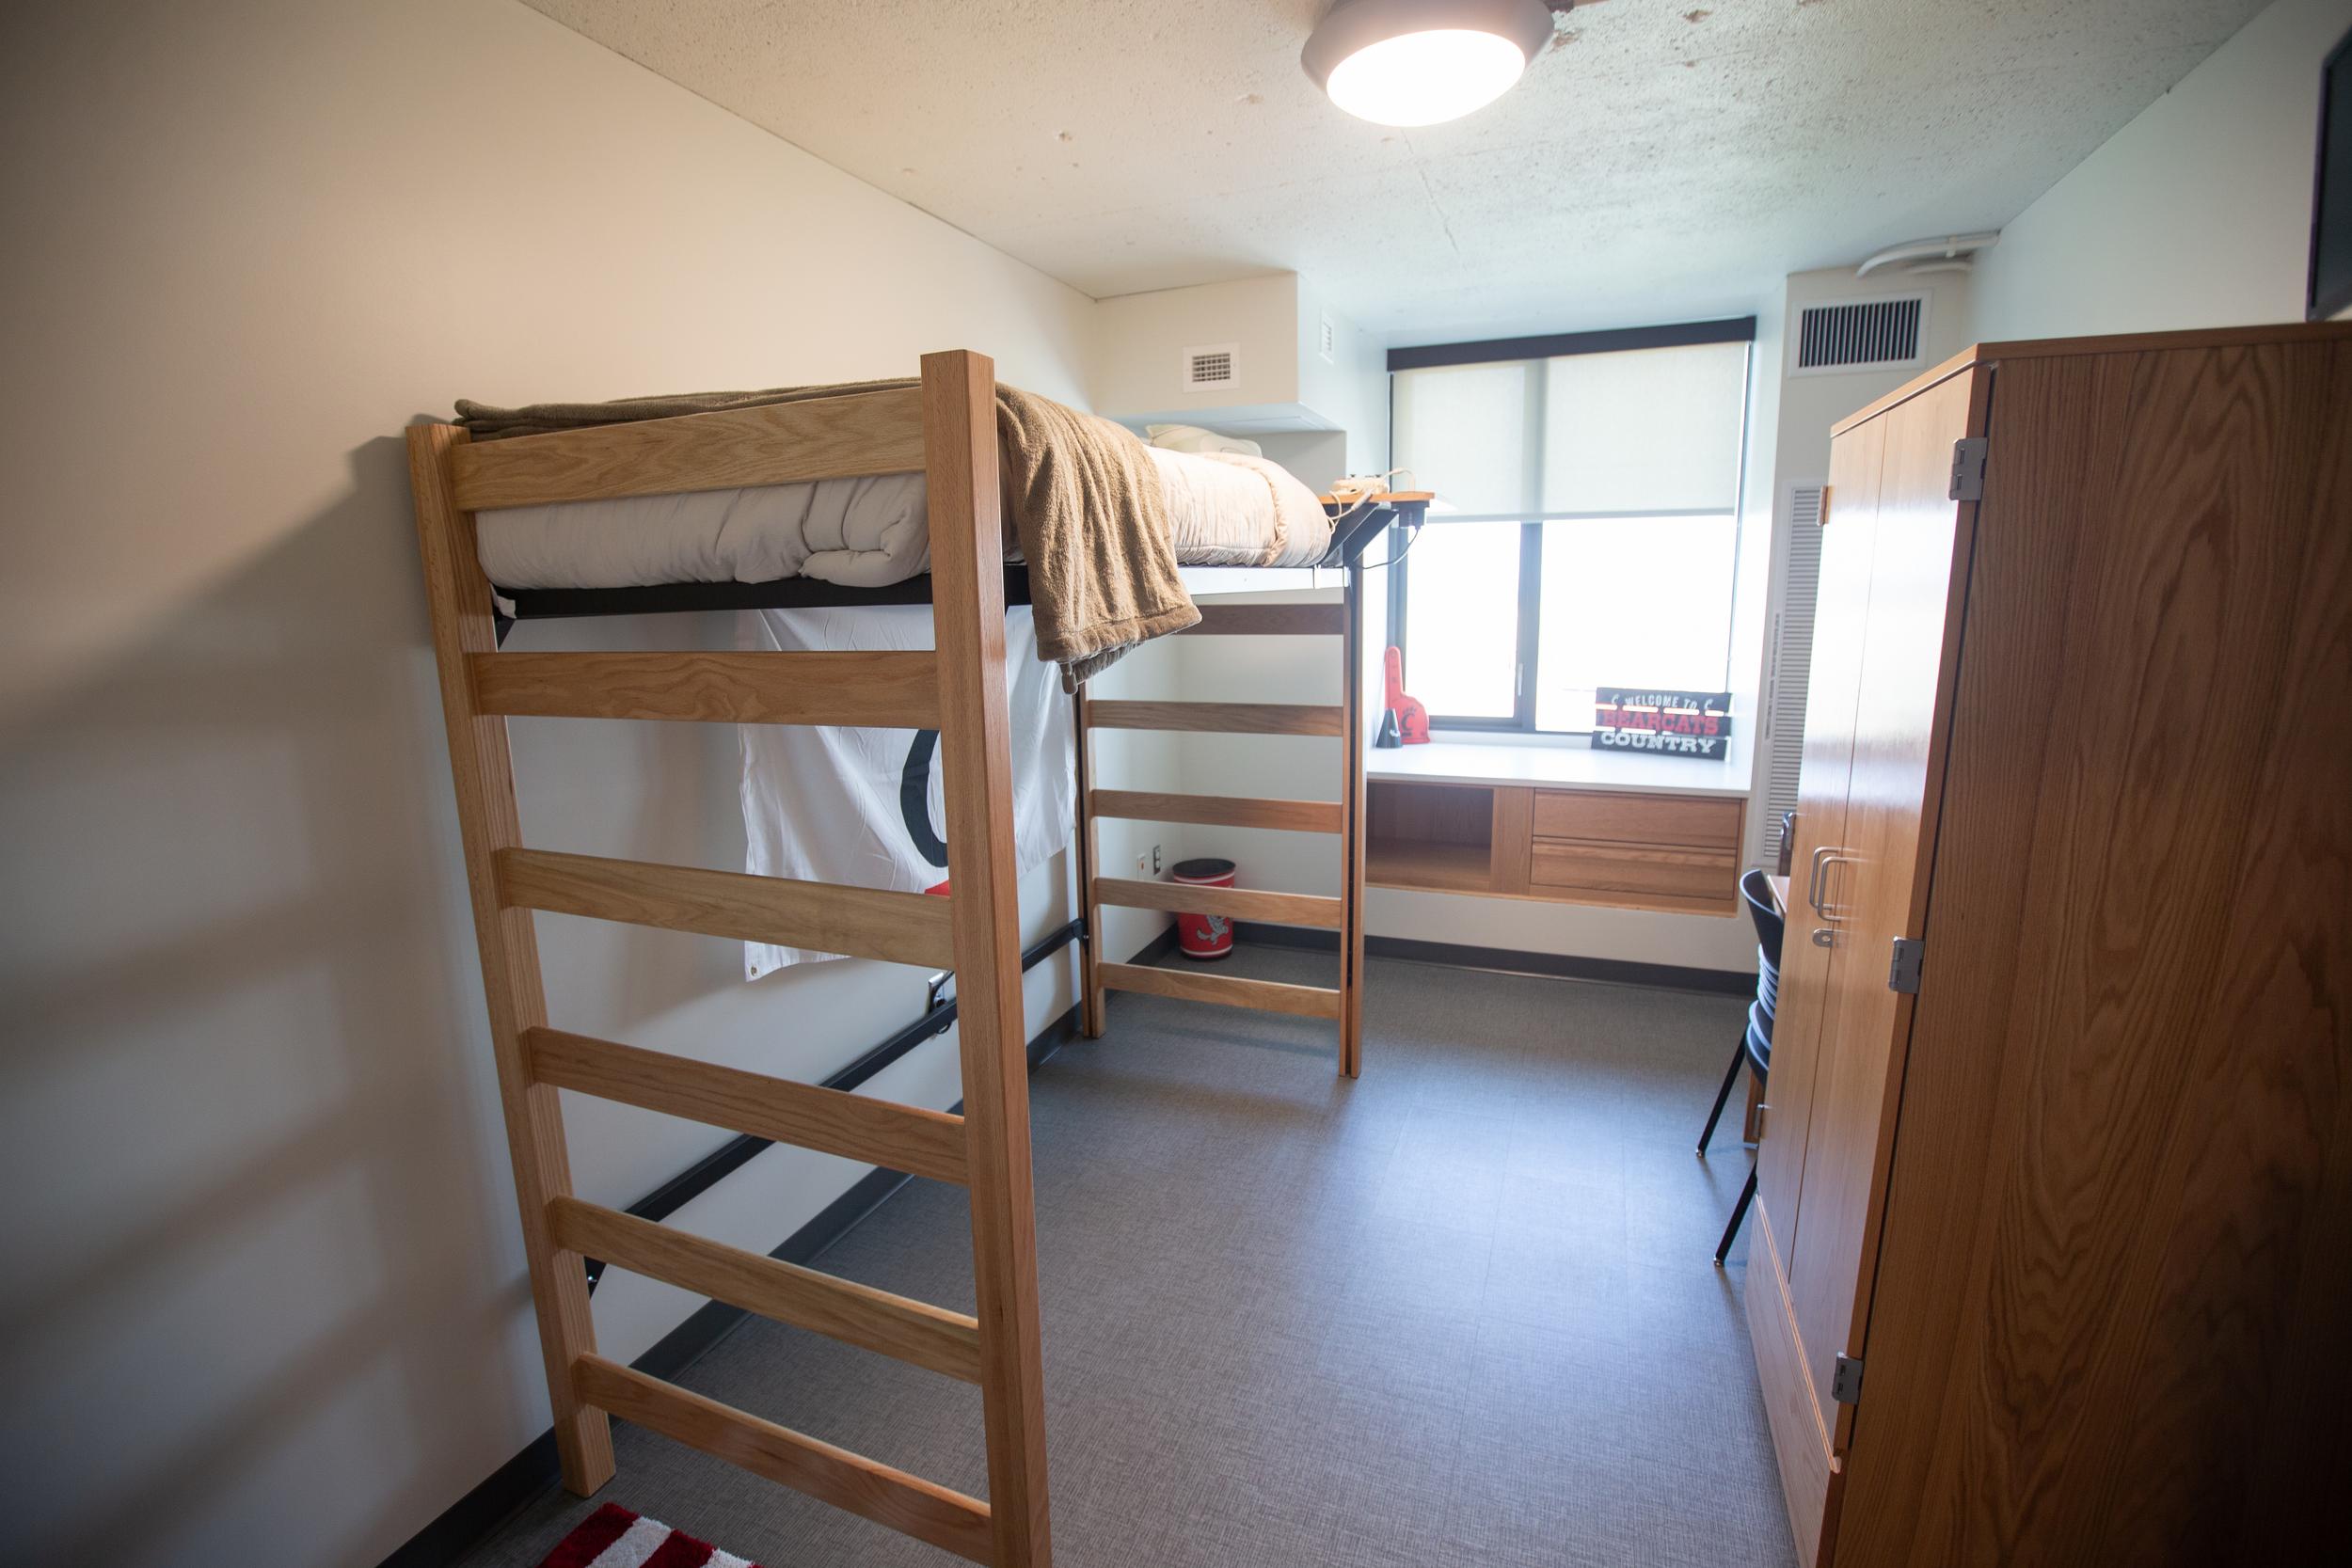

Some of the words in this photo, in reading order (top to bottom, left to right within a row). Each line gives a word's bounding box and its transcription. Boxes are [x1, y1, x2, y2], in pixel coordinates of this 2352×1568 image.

[1625, 694, 1678, 706] WELCOME
[1685, 698, 1697, 709] TO
[1604, 710, 1718, 736] BEARCATS
[1601, 732, 1717, 753] COUNTRY
